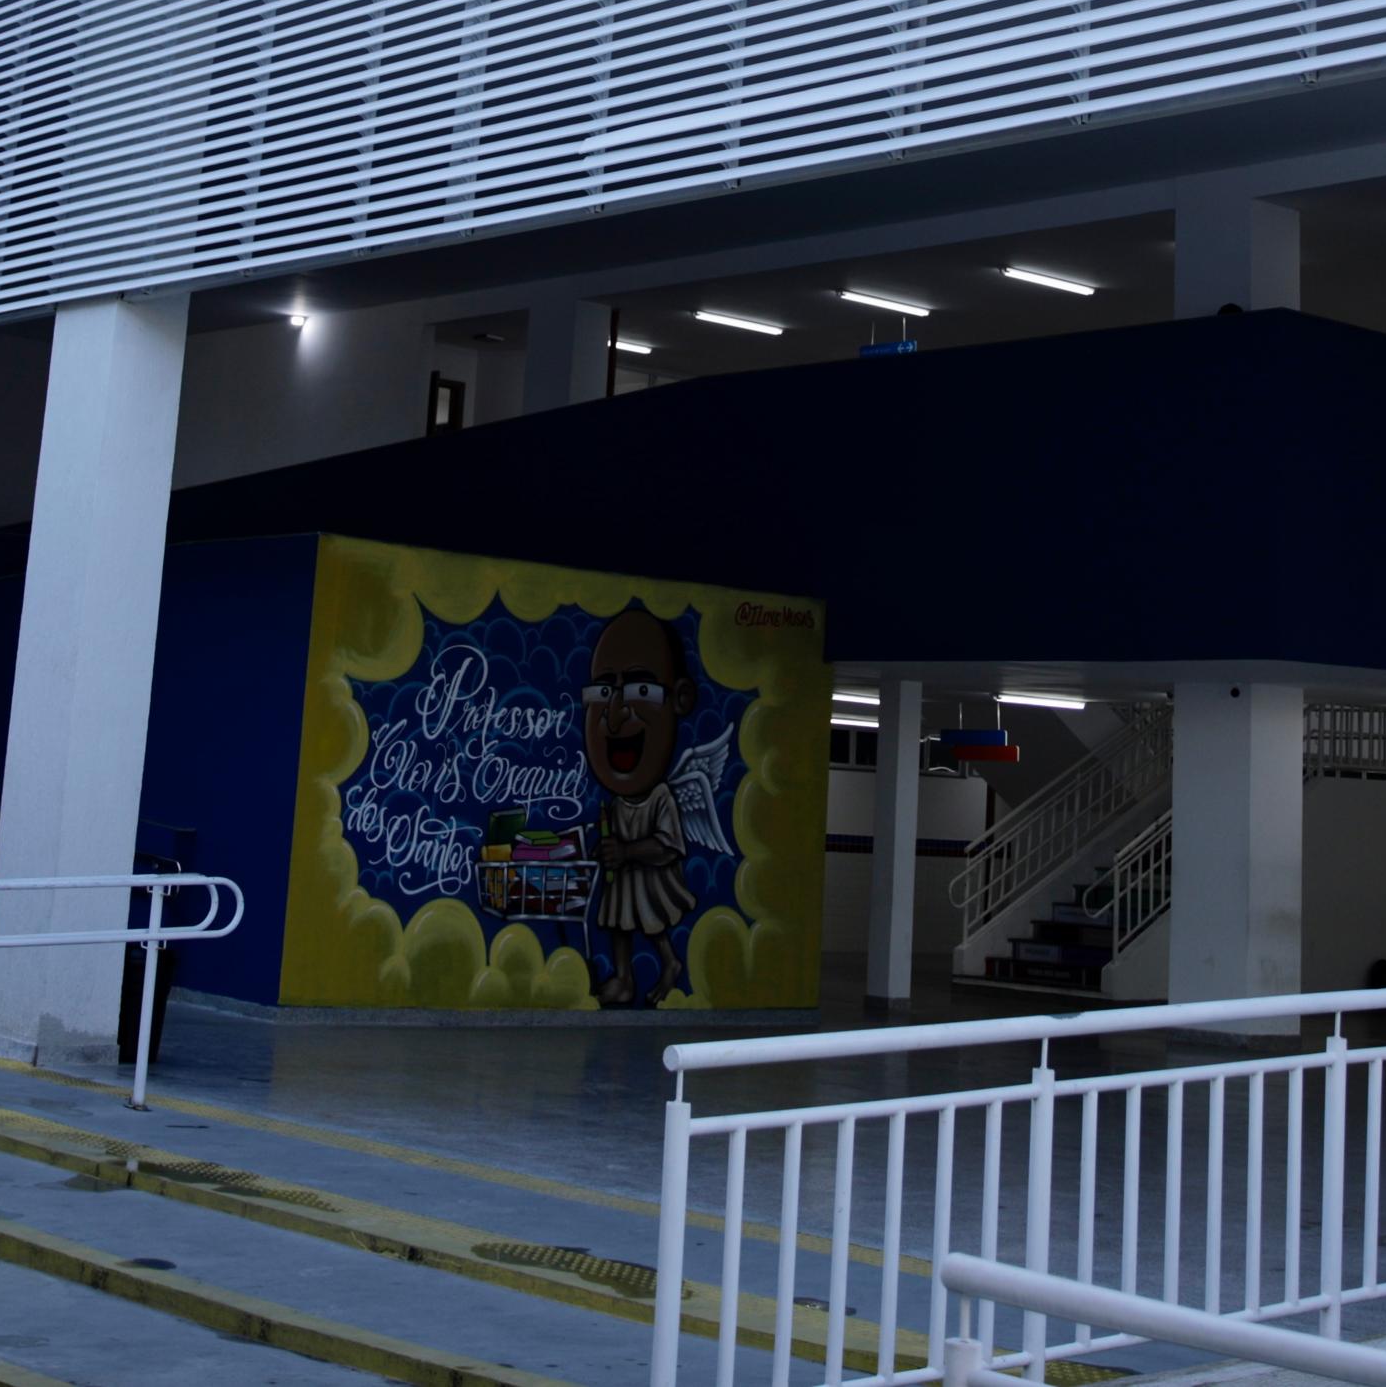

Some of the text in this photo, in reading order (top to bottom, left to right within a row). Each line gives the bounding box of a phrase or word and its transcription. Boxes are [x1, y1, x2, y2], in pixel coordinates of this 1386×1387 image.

[415, 644, 575, 760] Professor
[346, 785, 484, 895] dos Santos
